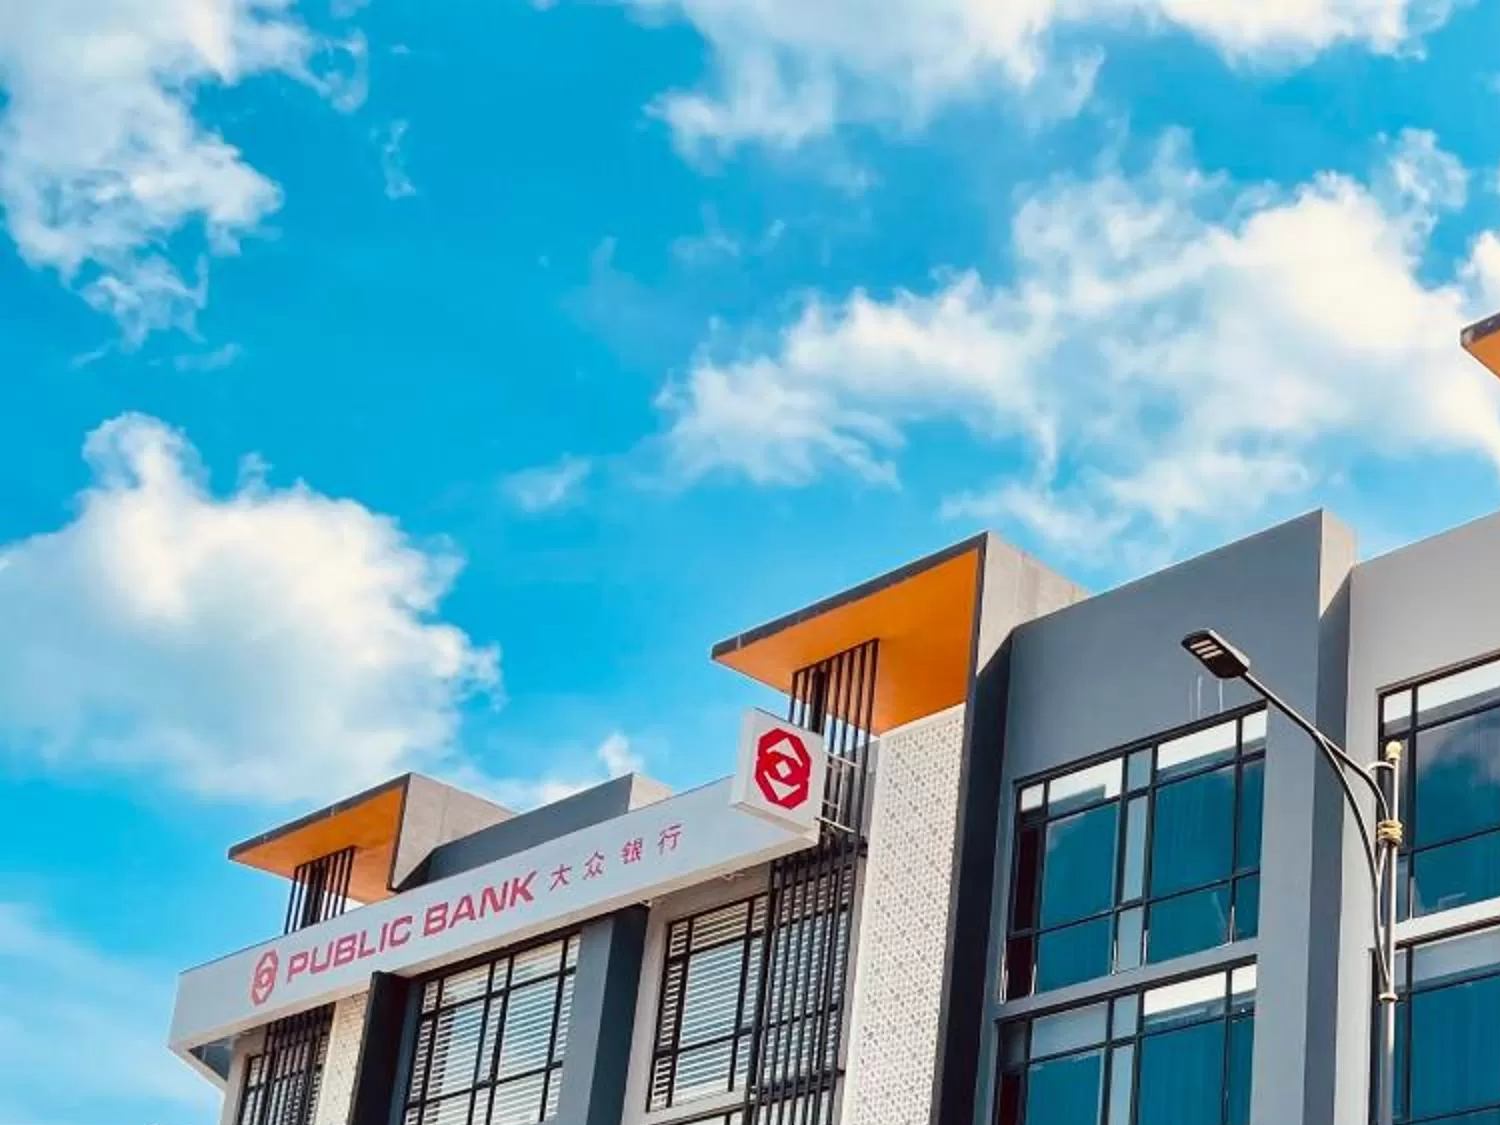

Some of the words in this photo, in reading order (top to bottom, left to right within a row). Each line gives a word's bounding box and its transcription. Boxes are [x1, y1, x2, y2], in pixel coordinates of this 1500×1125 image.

[548, 823, 683, 892] 大众银行
[286, 914, 414, 983] PUBLIC
[422, 870, 538, 938] BANK
